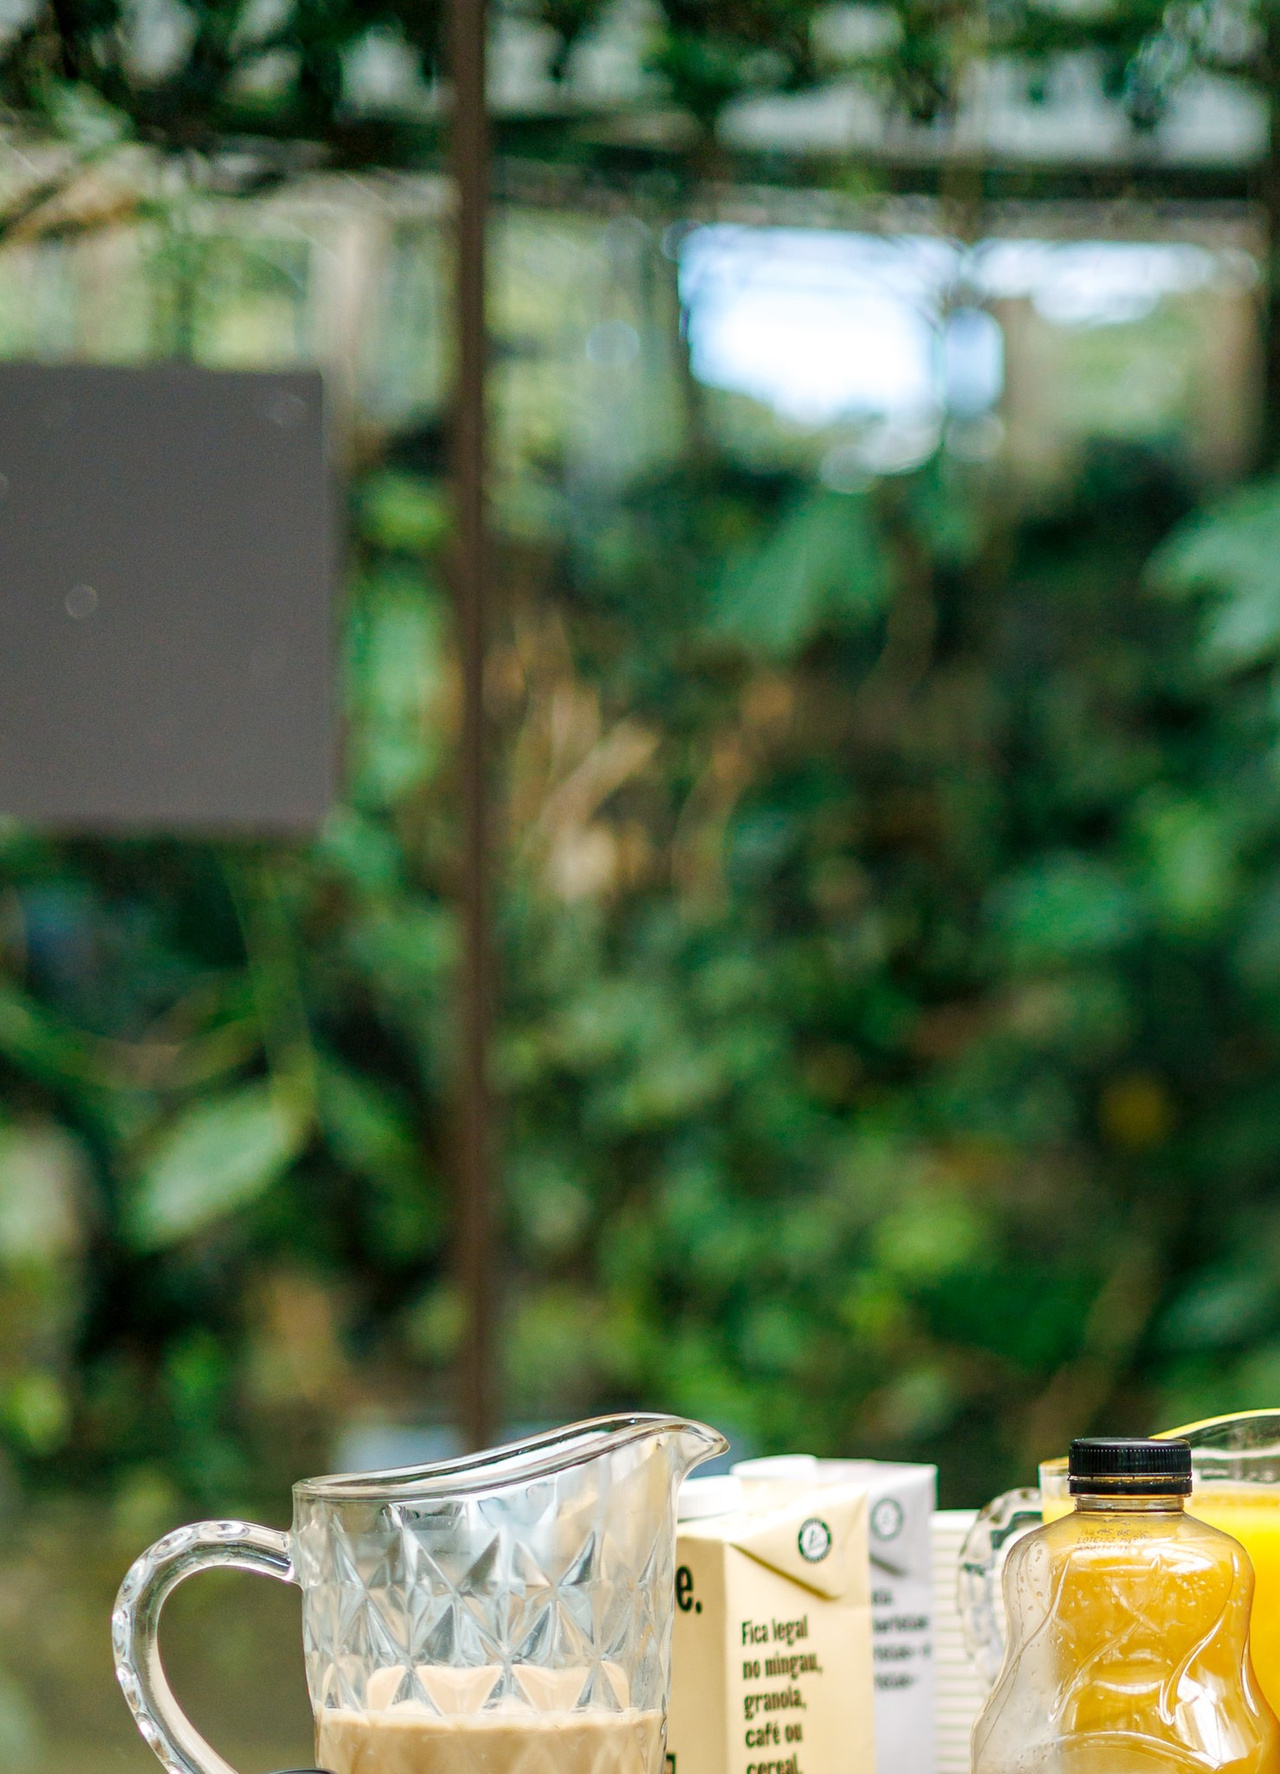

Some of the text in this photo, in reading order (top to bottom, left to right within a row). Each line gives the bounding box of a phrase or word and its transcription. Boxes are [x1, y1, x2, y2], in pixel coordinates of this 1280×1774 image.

[742, 1614, 809, 1647] Fica legal
[743, 1651, 823, 1681] no mingau,
[744, 1686, 807, 1720] granola,
[745, 1720, 804, 1748] café ou
